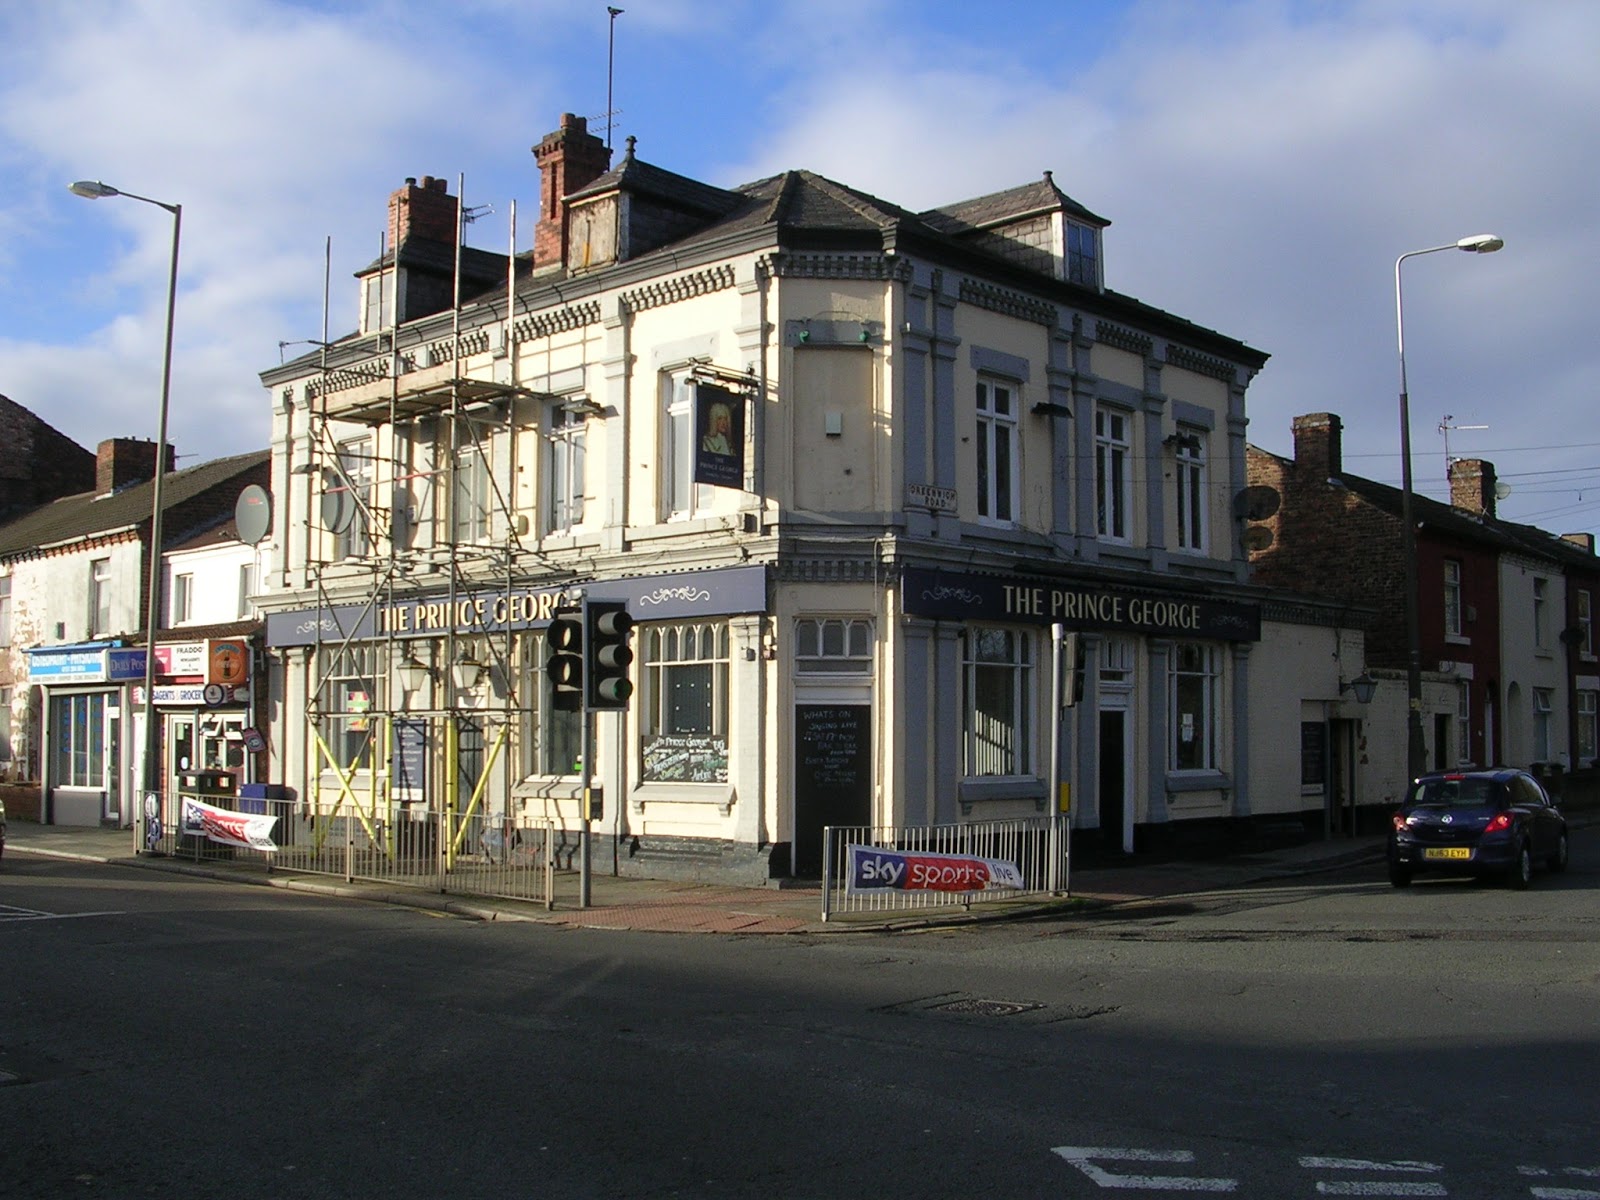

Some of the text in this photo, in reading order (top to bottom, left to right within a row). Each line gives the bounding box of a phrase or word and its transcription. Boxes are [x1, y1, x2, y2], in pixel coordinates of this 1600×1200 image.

[909, 484, 955, 500] GREENWICH
[924, 496, 946, 507] ROAD
[378, 591, 574, 632] HE PRINCE GEORG
[1002, 585, 1201, 630] THE PRINCE GEORGE
[131, 658, 147, 671] POS
[142, 689, 176, 702] NSAGENTS
[862, 855, 1014, 888] sky sports live
